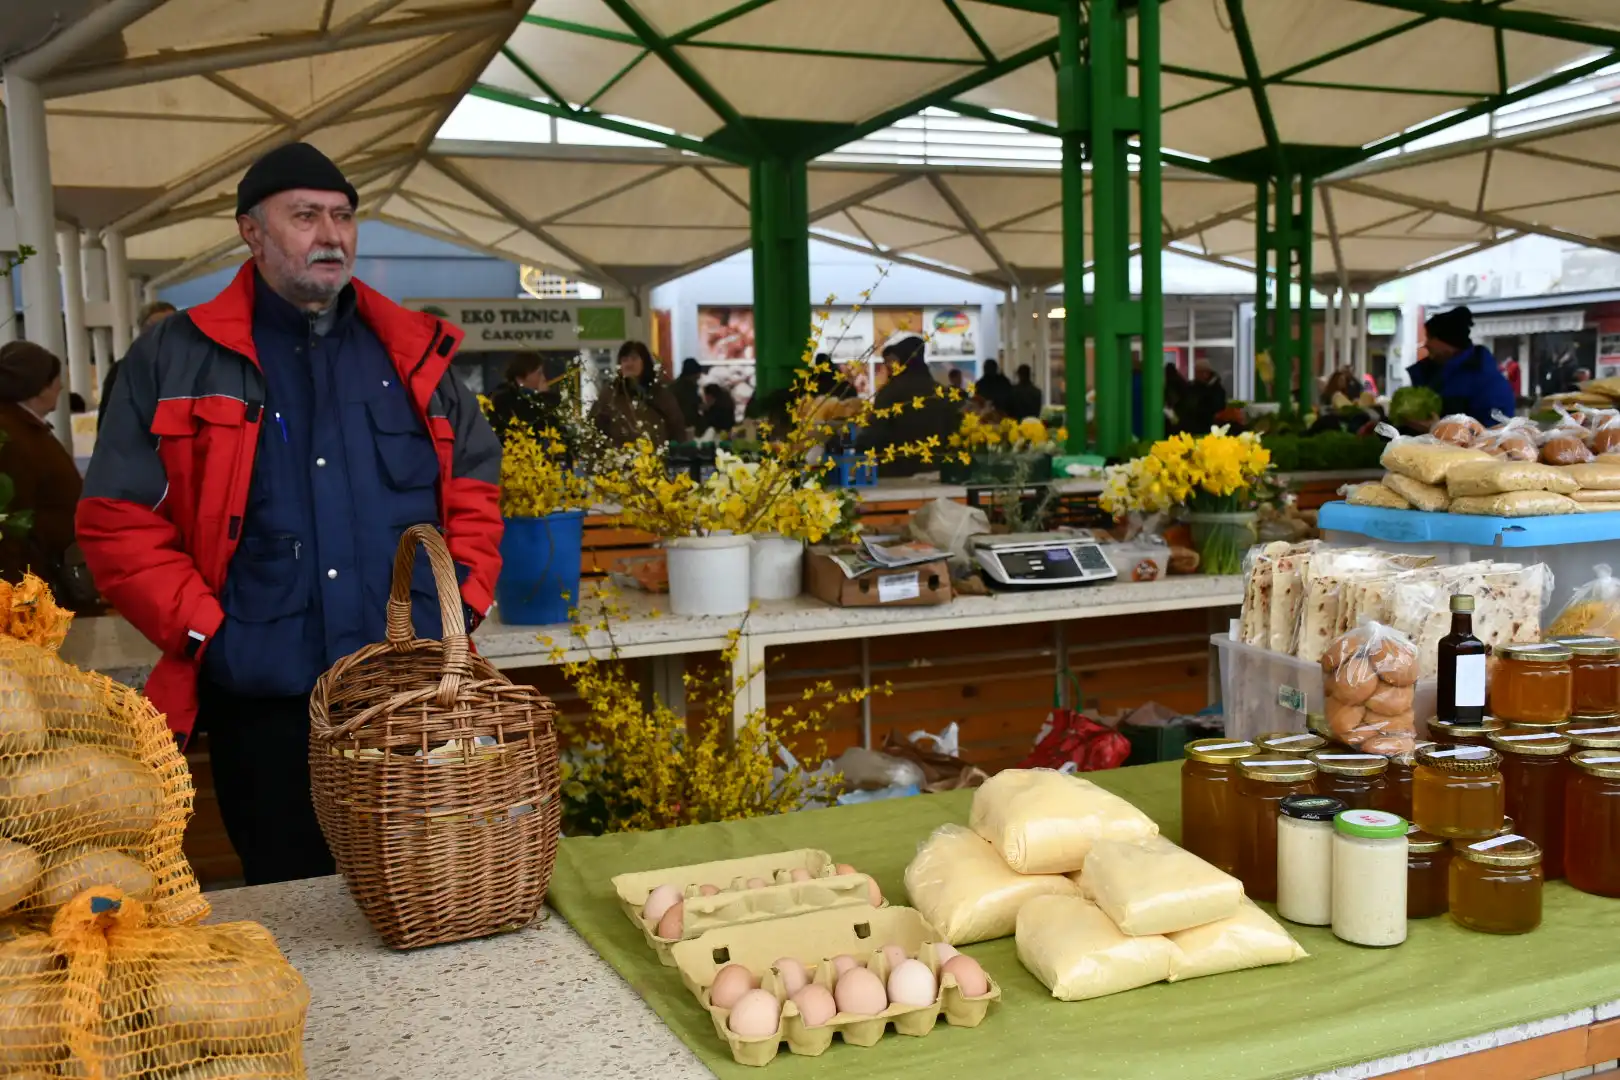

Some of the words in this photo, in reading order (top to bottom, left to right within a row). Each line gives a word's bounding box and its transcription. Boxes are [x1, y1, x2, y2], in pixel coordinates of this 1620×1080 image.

[461, 309, 496, 324] EKO
[500, 306, 571, 324] TRŽNICA
[482, 328, 554, 341] ČAKOVEC
